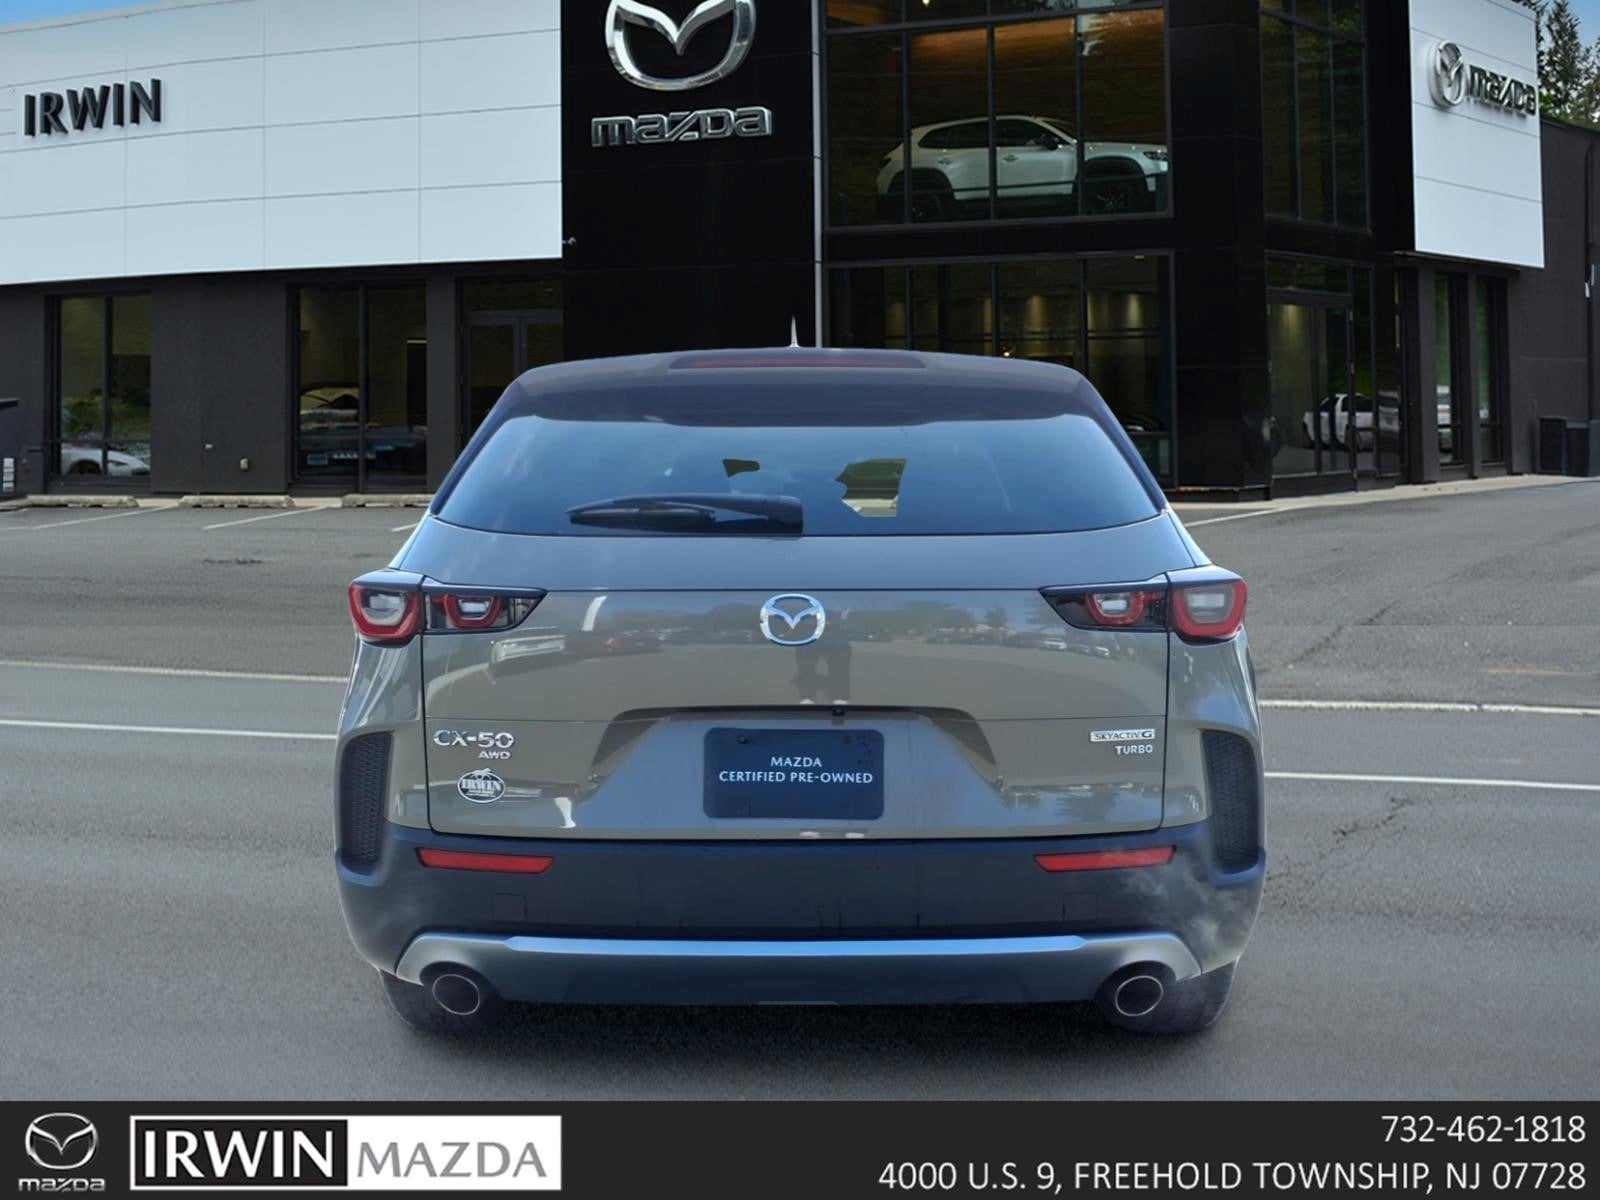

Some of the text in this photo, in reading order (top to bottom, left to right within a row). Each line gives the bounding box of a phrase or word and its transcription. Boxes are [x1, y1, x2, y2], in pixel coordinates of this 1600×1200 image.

[24, 78, 163, 137] IRWIN
[433, 729, 514, 748] CX-50
[478, 750, 511, 760] AWD
[1114, 744, 1153, 755] TURBO
[770, 756, 822, 768] MAZDA
[718, 770, 873, 784] CERTIFIED PRE-OWNED
[461, 779, 501, 791] IRWIN
